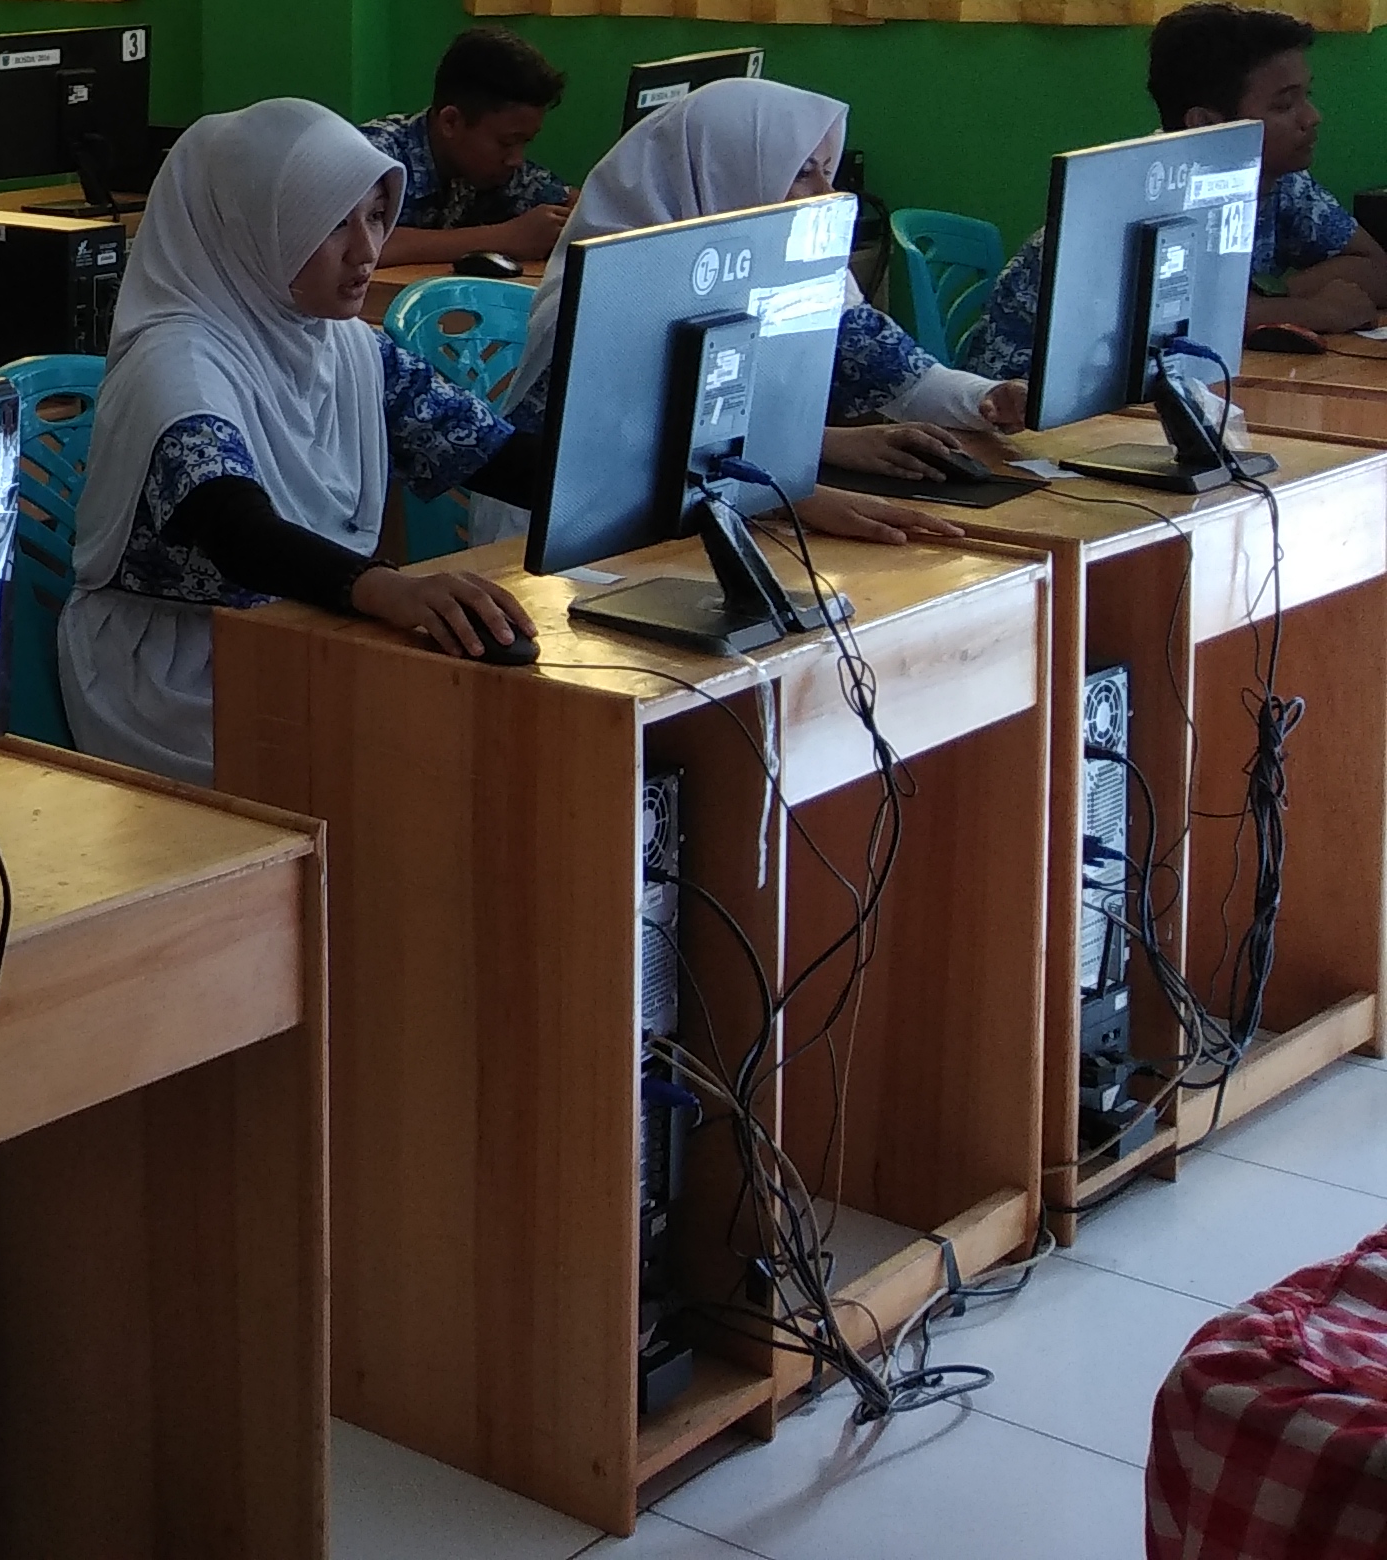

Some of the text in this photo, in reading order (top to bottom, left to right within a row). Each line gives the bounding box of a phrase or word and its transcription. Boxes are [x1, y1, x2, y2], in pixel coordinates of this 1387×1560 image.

[129, 32, 138, 58] 3
[751, 55, 760, 78] 2
[1167, 163, 1188, 190] LG
[722, 248, 751, 282] LG
